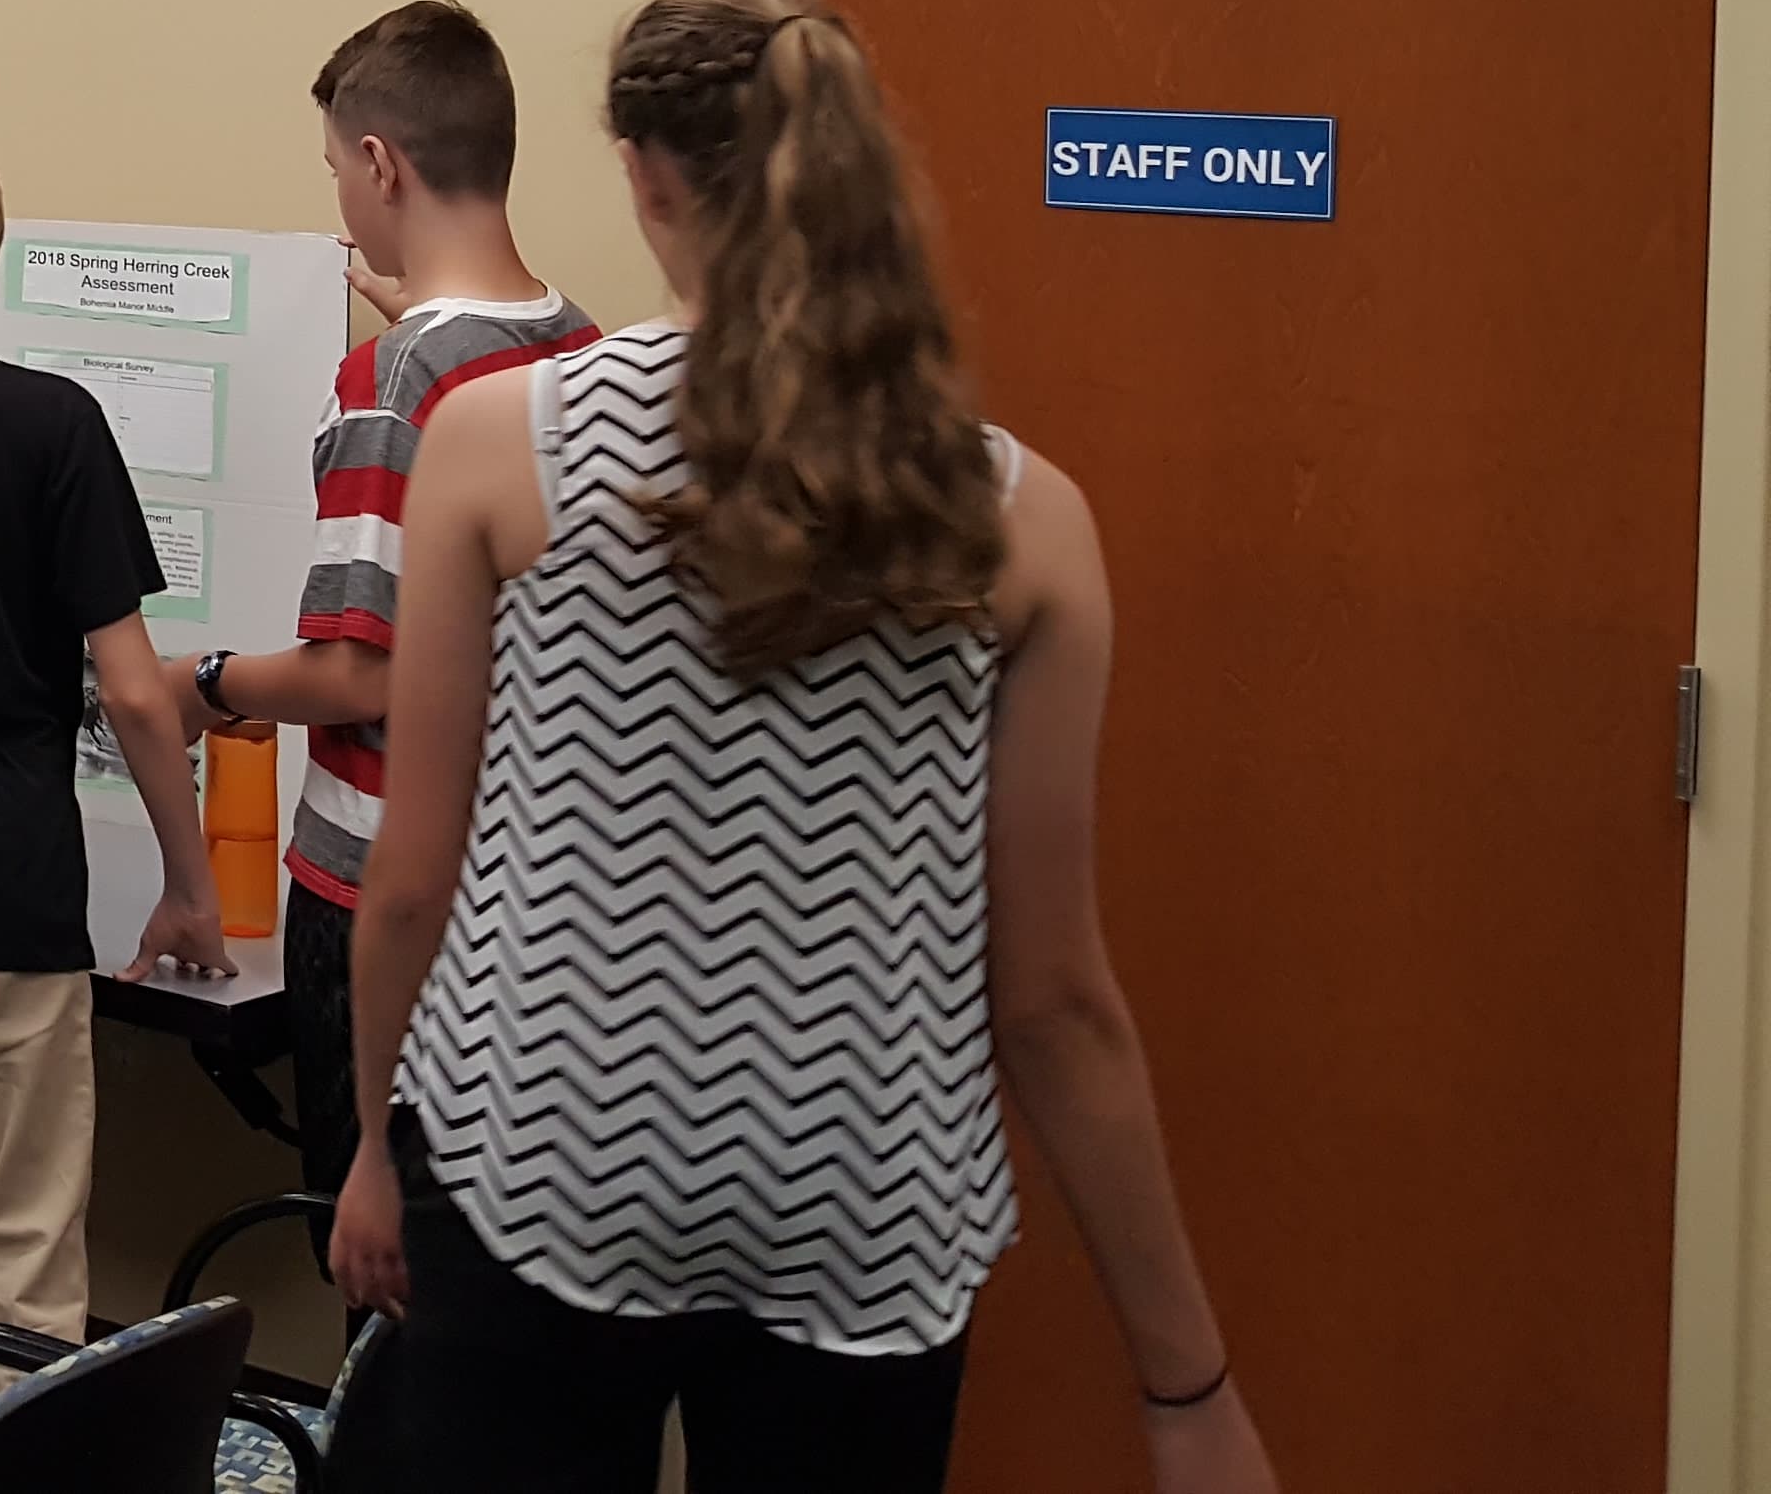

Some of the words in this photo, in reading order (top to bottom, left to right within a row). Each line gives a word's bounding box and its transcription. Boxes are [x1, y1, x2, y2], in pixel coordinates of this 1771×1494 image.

[1052, 141, 1191, 181] STAFF
[1203, 147, 1327, 187] ONLY
[28, 250, 65, 266] 2018
[69, 253, 118, 273] Spring
[123, 257, 179, 278] Herring
[184, 262, 230, 279] Creek
[81, 274, 175, 295] Assessment
[80, 297, 117, 309] Bohemia
[118, 300, 145, 311] Manor
[147, 302, 175, 314] Middle
[83, 357, 124, 371] Biological
[125, 361, 155, 374] Survey
[145, 513, 172, 525] ment
